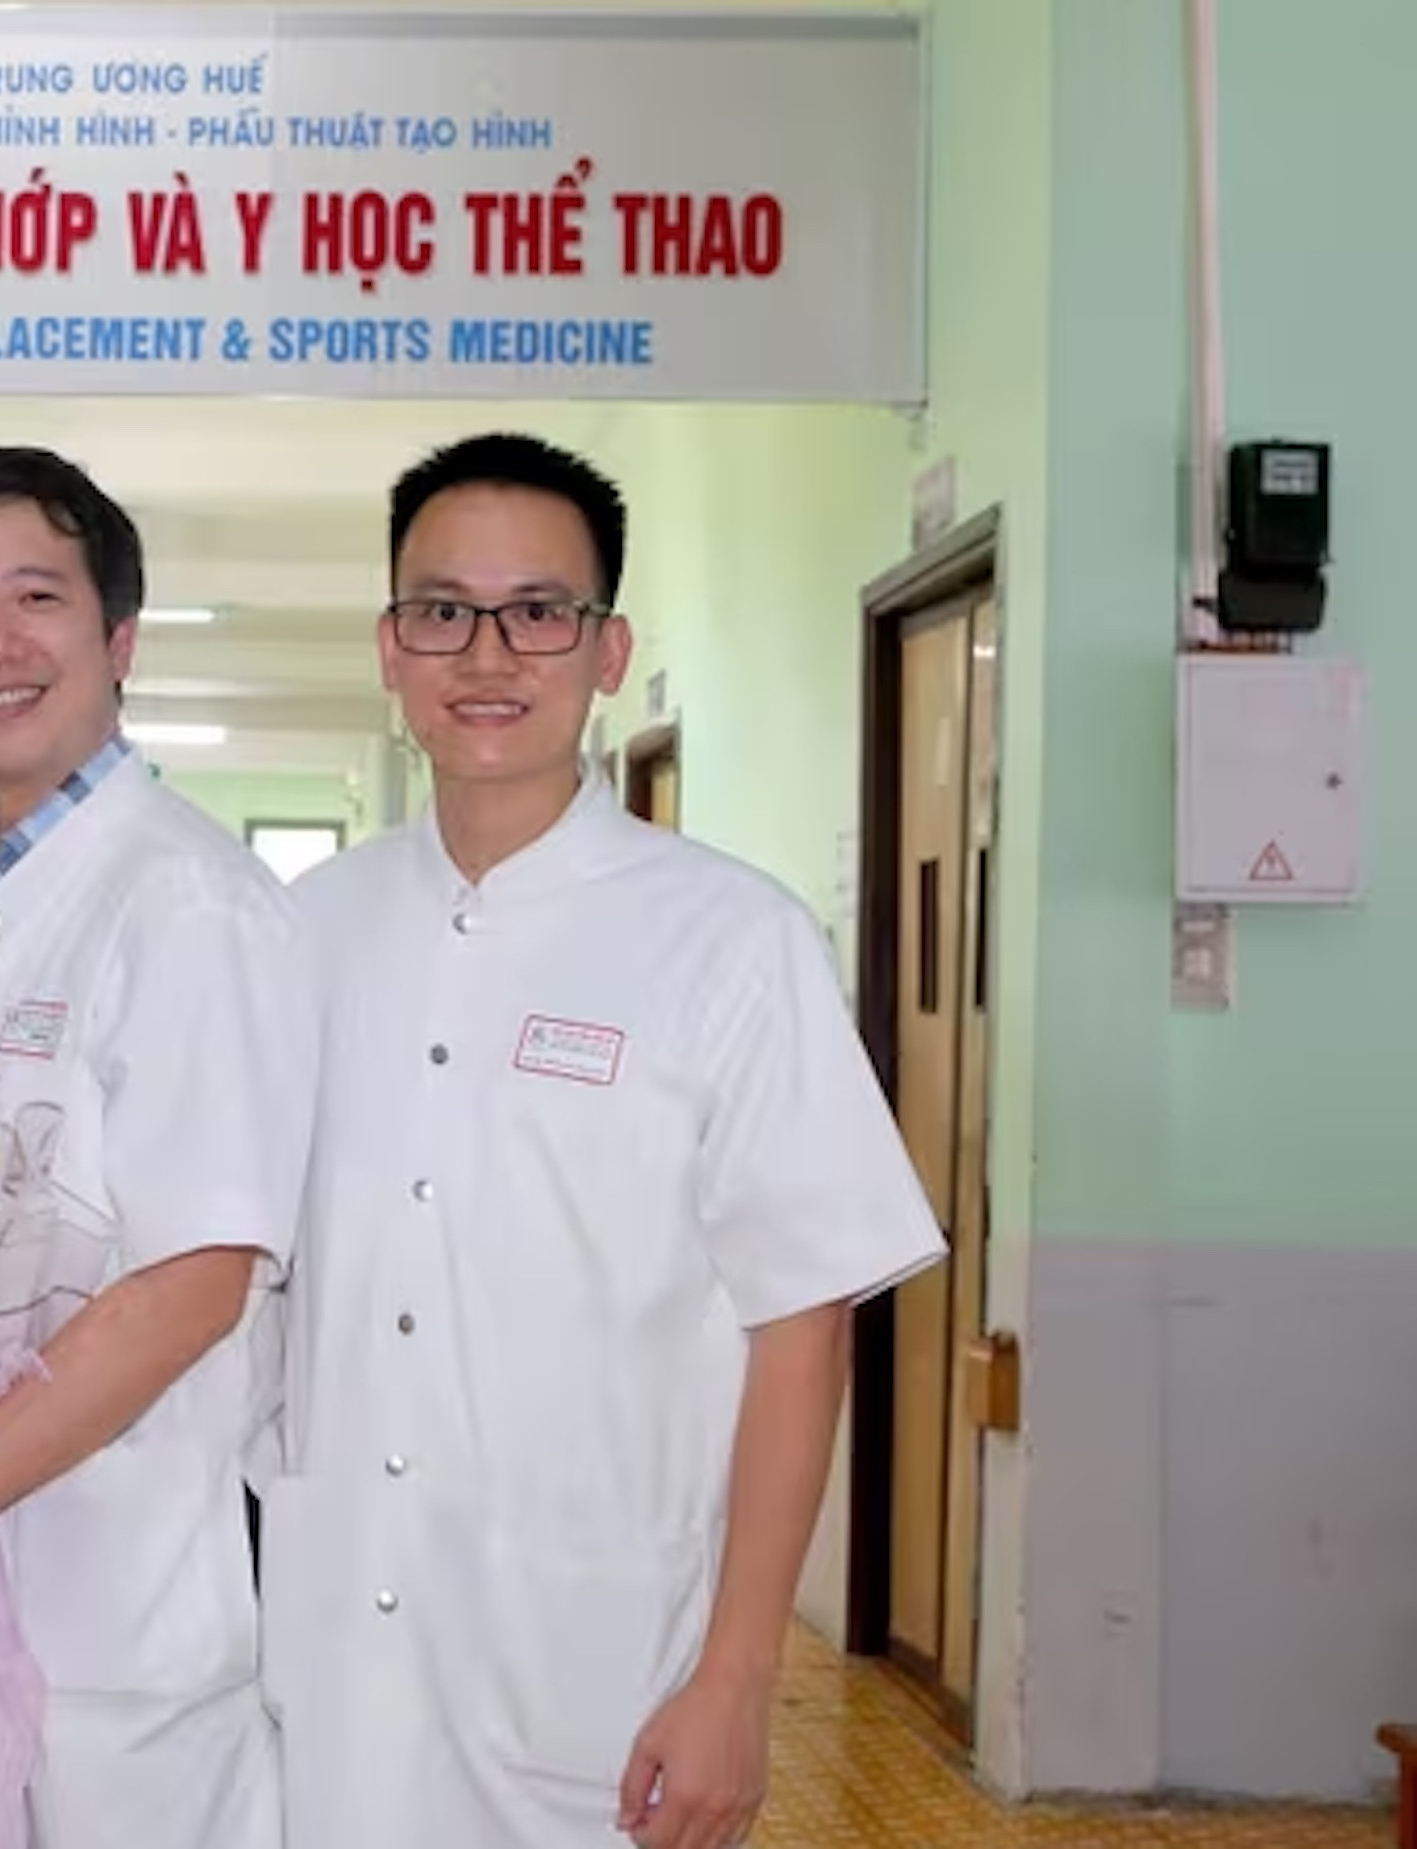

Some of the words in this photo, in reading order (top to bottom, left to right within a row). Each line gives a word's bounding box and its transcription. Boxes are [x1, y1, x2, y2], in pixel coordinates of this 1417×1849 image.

[93, 60, 187, 93] ƯƠNG
[203, 52, 268, 93] HUẾ
[76, 109, 154, 146] HÌNH
[188, 106, 275, 147] PHẪU
[288, 111, 385, 150] THUẬT
[396, 117, 456, 153] TẠO
[472, 110, 552, 150] HÌNH
[127, 171, 207, 275] VÀ
[235, 192, 274, 275] Y
[303, 190, 435, 294] HỌC
[465, 157, 594, 276] THỂ
[614, 193, 782, 276] THAO
[222, 318, 251, 362] &
[269, 319, 430, 363] SPORTS
[450, 320, 653, 365] MEDICINE
